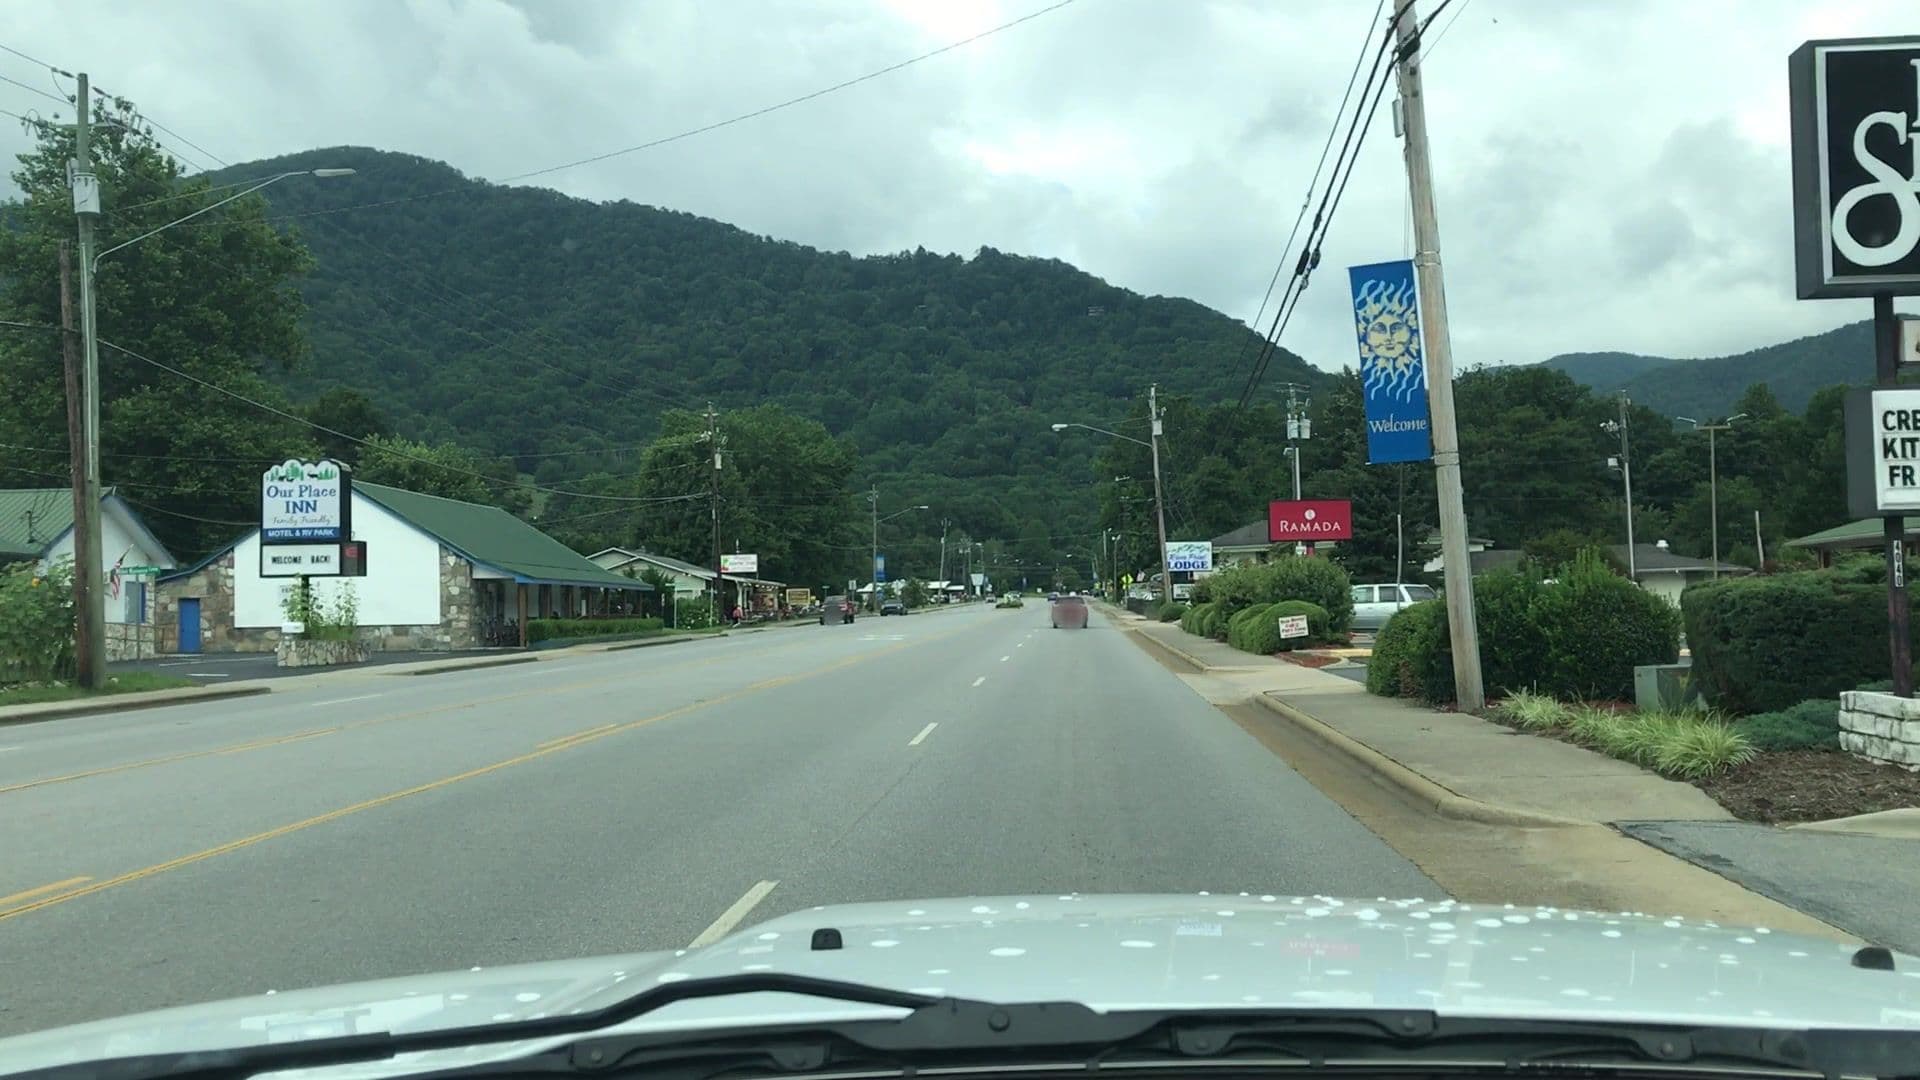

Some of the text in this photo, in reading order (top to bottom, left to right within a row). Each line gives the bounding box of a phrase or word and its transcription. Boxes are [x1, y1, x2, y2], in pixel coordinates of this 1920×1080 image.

[1369, 413, 1427, 433] Welcome
[1889, 465, 1916, 487] FR
[267, 485, 337, 498] Our Place
[285, 500, 317, 513] INN
[314, 529, 335, 537] PARK
[1280, 520, 1341, 533] RAMADA
[271, 556, 302, 564] WELCOME
[1168, 560, 1209, 570] LODGE
